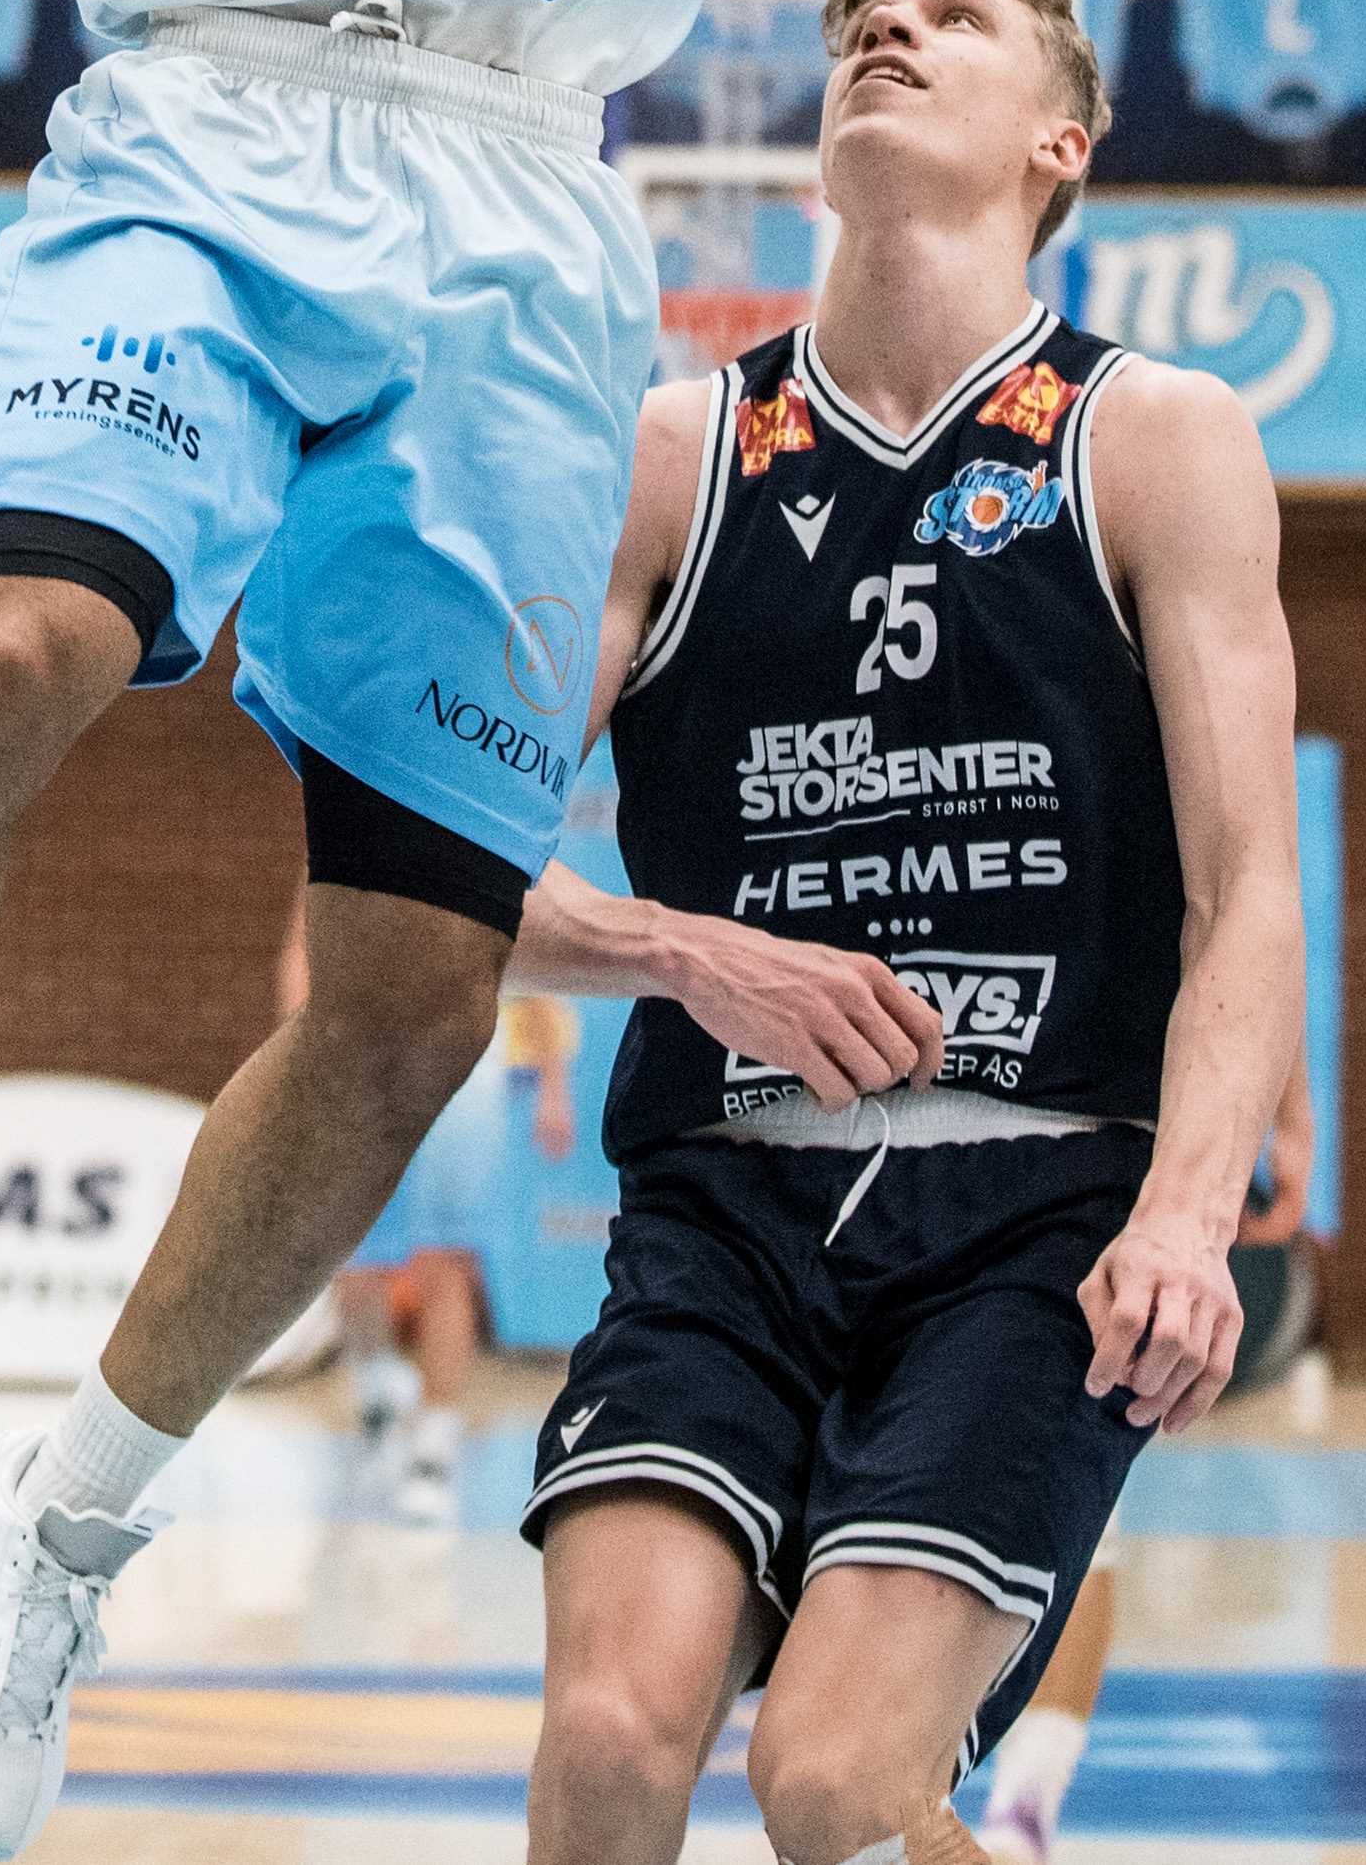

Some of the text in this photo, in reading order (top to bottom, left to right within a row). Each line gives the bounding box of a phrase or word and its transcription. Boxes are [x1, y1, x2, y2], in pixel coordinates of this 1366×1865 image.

[5, 377, 202, 462] MYRENS
[34, 408, 176, 458] treningssenter
[849, 562, 939, 696] 25
[735, 714, 874, 775] JEKTA
[738, 740, 1057, 822] STORSENTER
[922, 795, 1060, 818] STØRST I NORD
[732, 838, 1068, 917] HERMES
[981, 1053, 1022, 1089] AS
